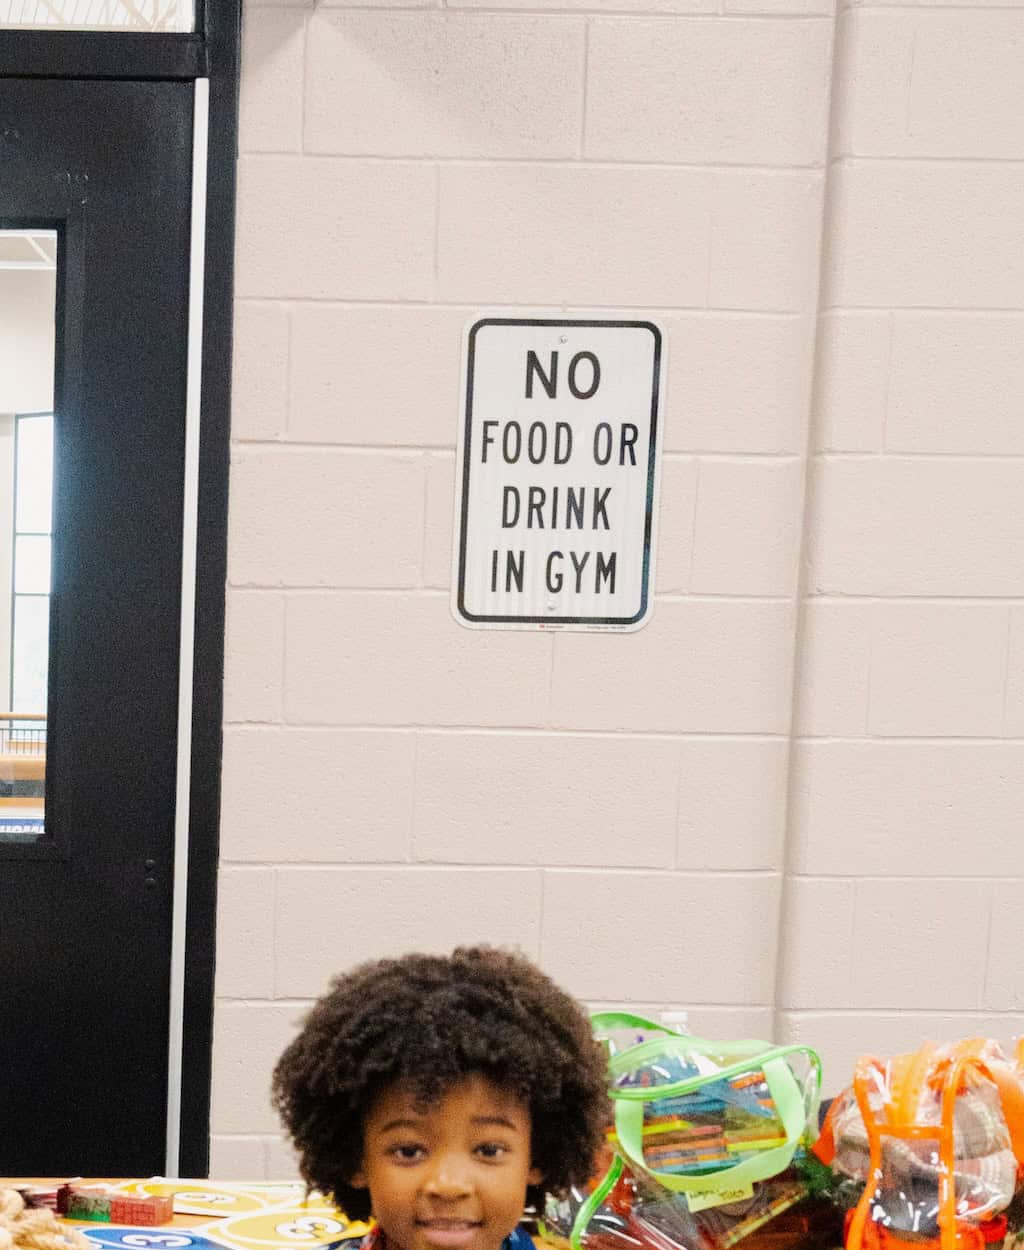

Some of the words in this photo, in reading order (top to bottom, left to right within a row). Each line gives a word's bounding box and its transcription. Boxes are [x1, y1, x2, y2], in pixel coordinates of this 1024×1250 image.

[525, 350, 601, 400] NO
[481, 421, 573, 464] FOOD
[593, 422, 639, 466] OR
[501, 486, 612, 530] DRINK
[491, 550, 525, 594] IN
[546, 551, 617, 594] GYM
